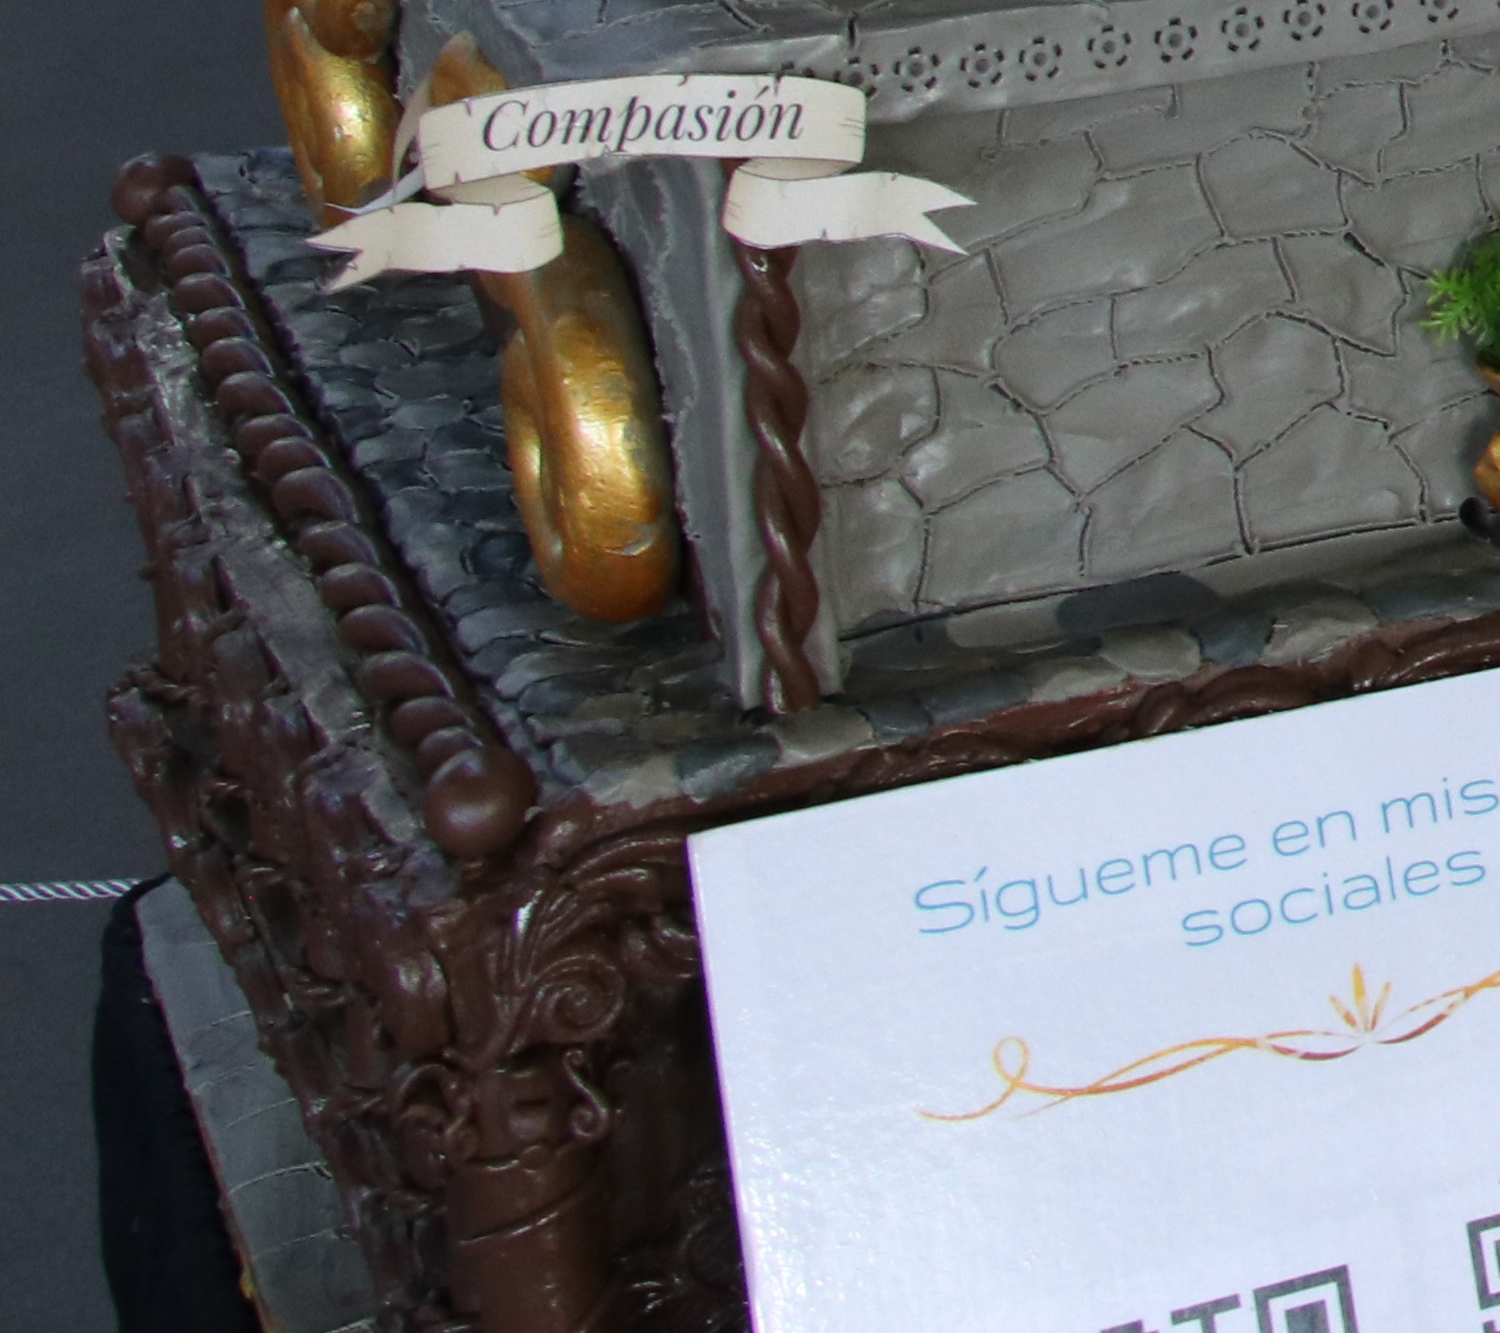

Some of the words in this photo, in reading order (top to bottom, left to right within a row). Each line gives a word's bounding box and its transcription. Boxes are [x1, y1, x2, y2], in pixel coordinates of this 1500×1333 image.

[482, 83, 803, 153] Compasión
[911, 828, 1248, 936] Sígueme
[1270, 801, 1357, 858] en
[1380, 773, 1500, 839] mis
[1180, 843, 1487, 949] sociales
